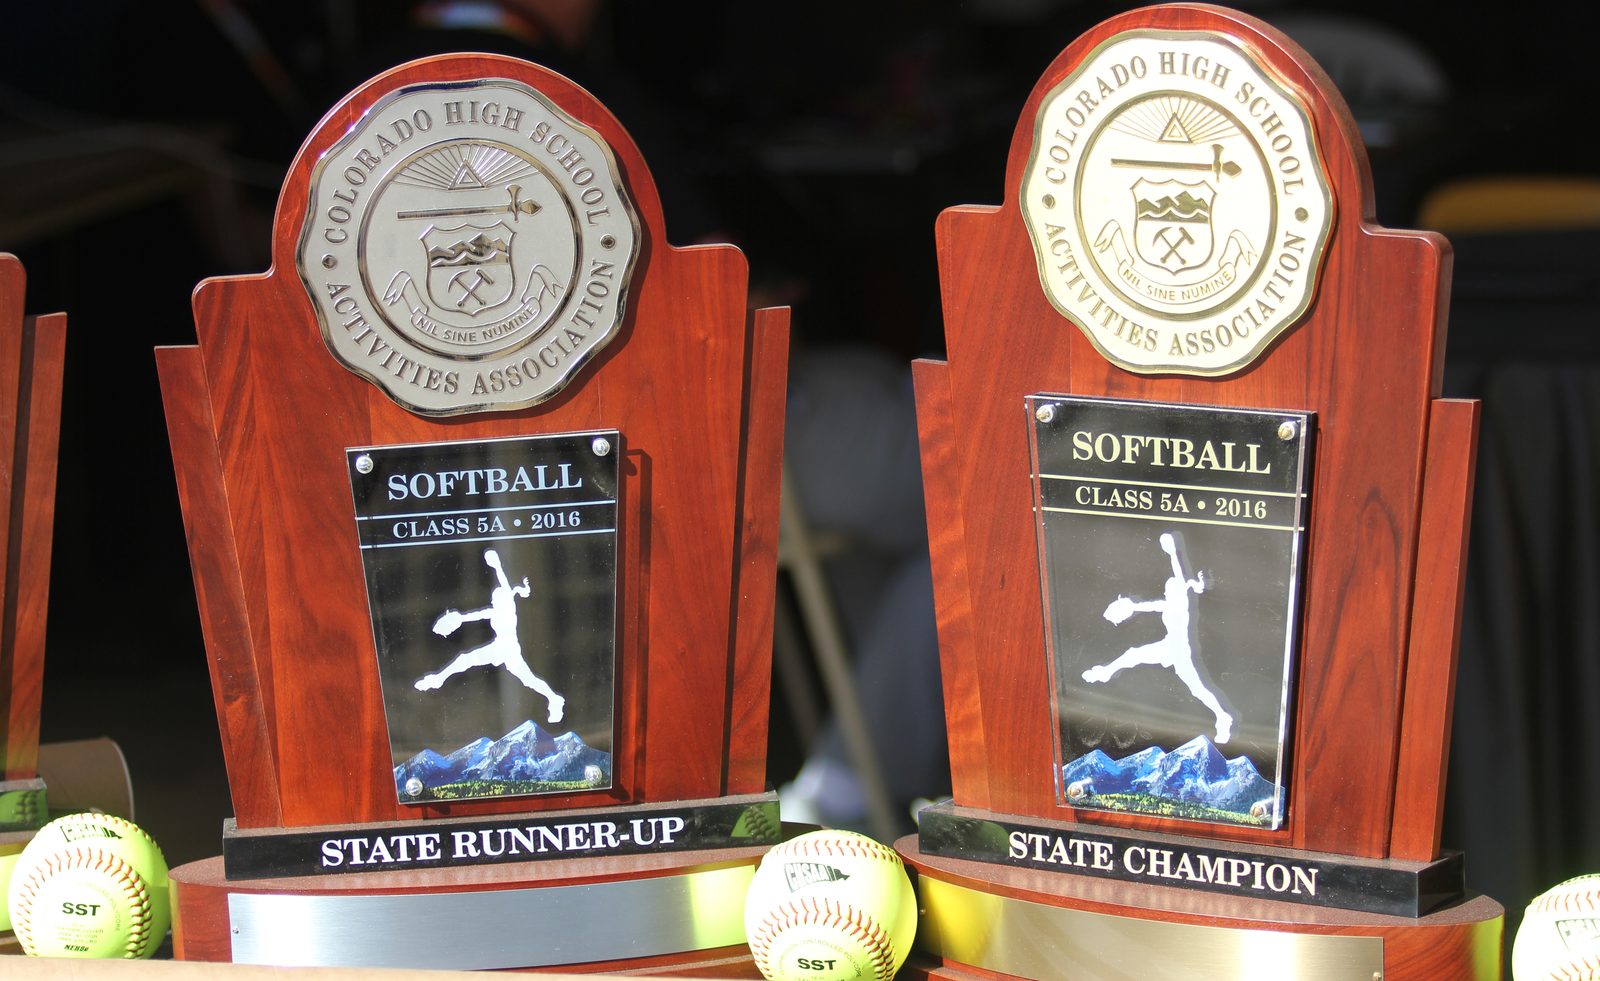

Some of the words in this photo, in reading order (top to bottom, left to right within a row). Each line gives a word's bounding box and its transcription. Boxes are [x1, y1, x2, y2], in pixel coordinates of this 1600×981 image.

[1045, 54, 1148, 186] COLORADO
[1159, 51, 1233, 89] HIGH
[1235, 81, 1306, 197] SCHOOL
[323, 108, 433, 245] COLORADO
[444, 100, 526, 132] HIGH
[529, 120, 611, 226] SCHOOL
[1044, 222, 1158, 352] ACTIVITIES
[1168, 230, 1307, 358] ASSOCIATION
[1122, 268, 1142, 292] NIL
[1147, 284, 1177, 302] SINE
[1181, 270, 1233, 301] NUMINE
[326, 281, 460, 396] ACTIVITIES
[471, 259, 616, 396] ASSOCIATION
[416, 317, 438, 339] NIL
[443, 330, 478, 343] SINE
[482, 306, 538, 342] NUMINE
[1071, 430, 1271, 475] SOFTBALL
[387, 463, 583, 501] SOFTBALL
[1075, 485, 1153, 511] CLASS
[1159, 492, 1190, 514] 5A
[1215, 498, 1267, 520] 2016
[392, 518, 470, 539] CLASS
[476, 516, 507, 533] 5A
[530, 511, 582, 530] 2016
[321, 833, 442, 868] STATE
[451, 816, 685, 859] RUNNER-UP
[1008, 831, 1114, 871] STATE
[1123, 846, 1319, 897] CHAMPION
[62, 902, 101, 917] SST
[797, 958, 837, 970] SST
